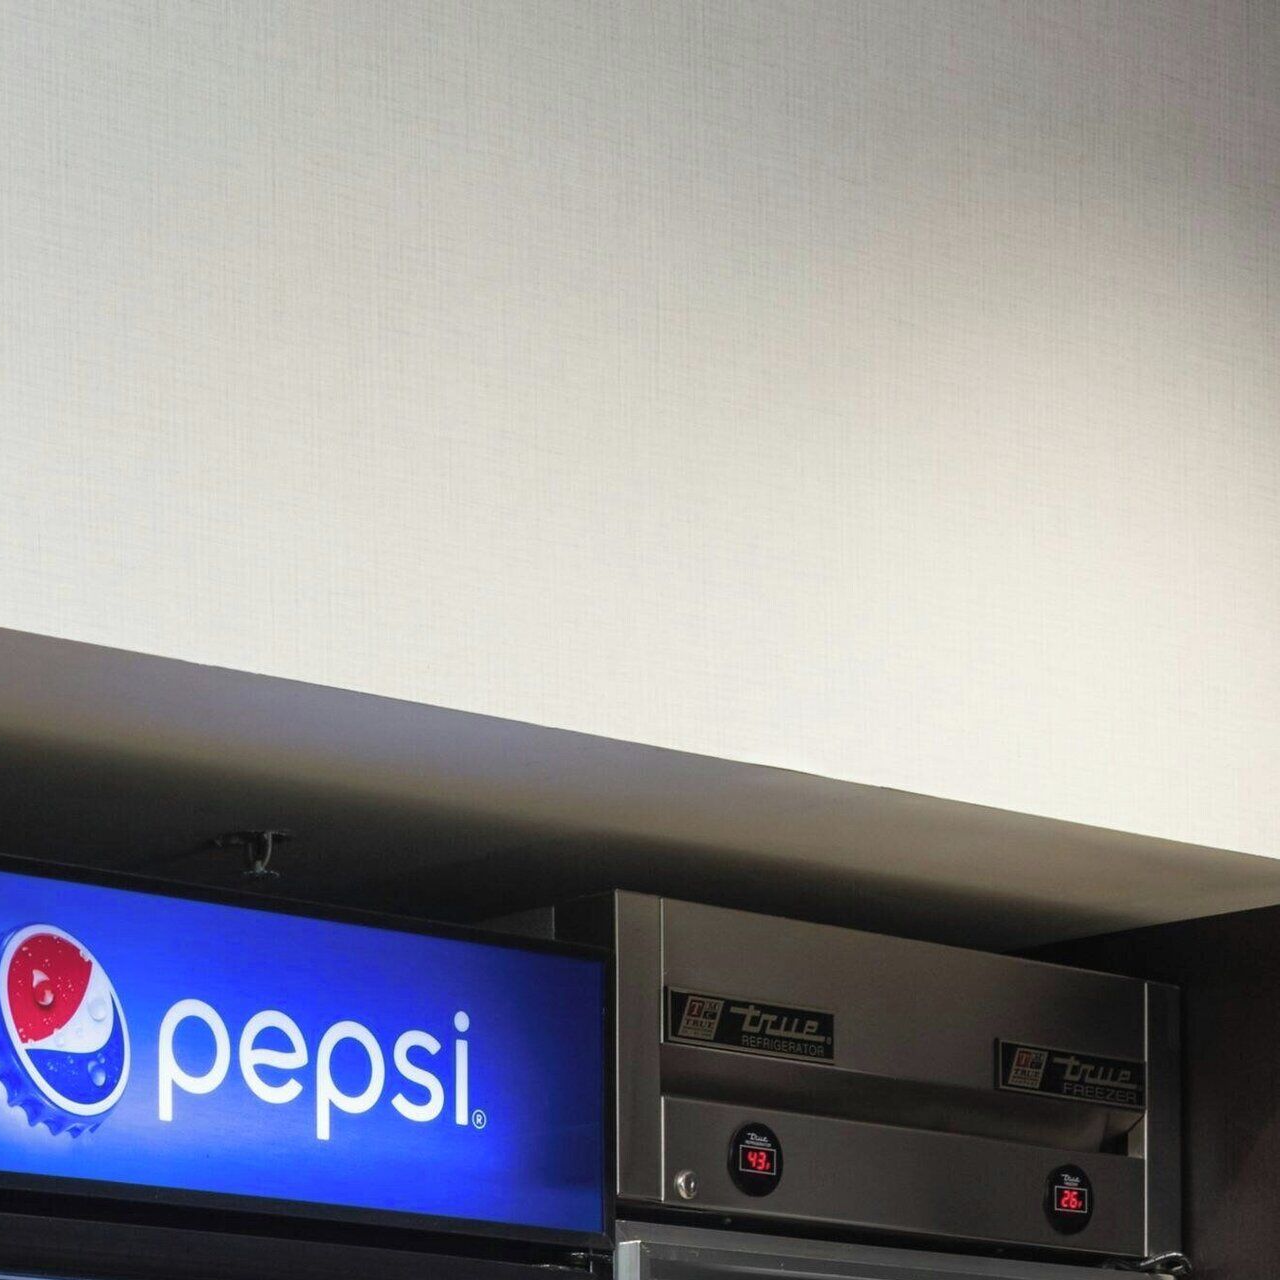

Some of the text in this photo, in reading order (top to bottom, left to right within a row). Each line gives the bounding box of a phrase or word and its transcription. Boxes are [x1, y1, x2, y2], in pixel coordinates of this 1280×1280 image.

[741, 1034, 825, 1057] REFRIGERATOR
[157, 998, 470, 1141] pepsi
[1063, 1081, 1137, 1102] FREEZER
